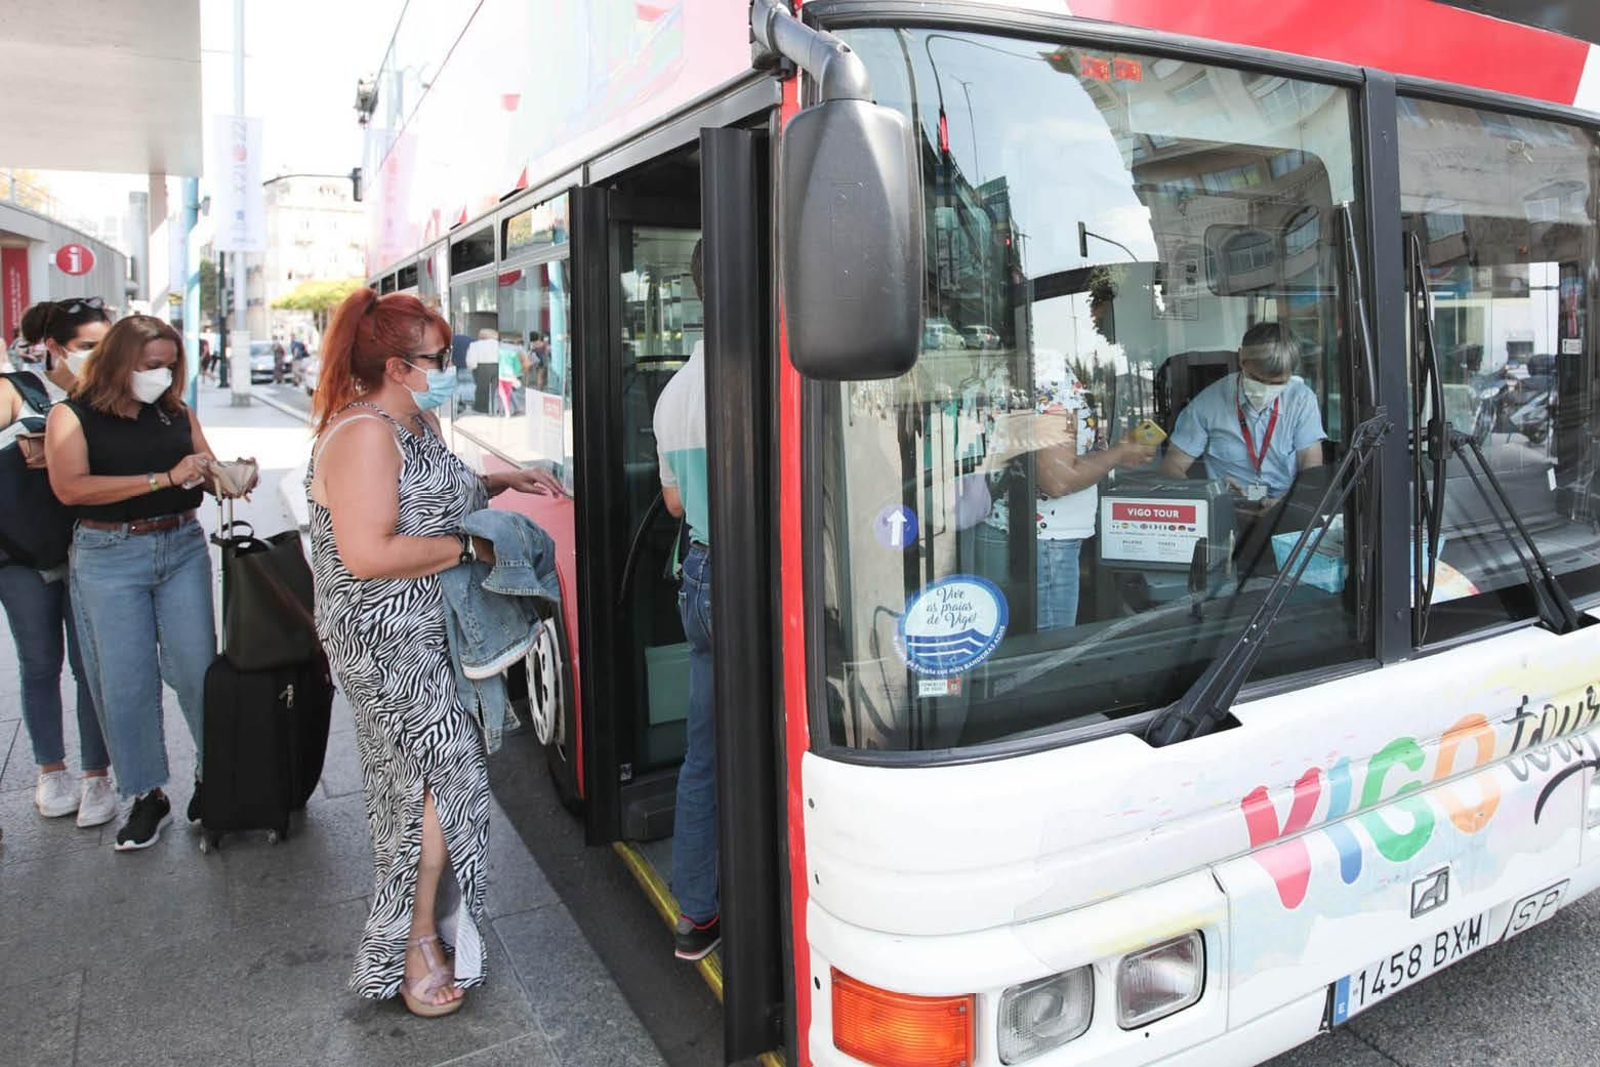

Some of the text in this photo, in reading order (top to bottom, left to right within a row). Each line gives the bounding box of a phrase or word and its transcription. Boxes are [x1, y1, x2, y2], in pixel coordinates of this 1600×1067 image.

[1127, 507, 1180, 518] VIGO TOUR
[936, 587, 966, 603] Vive
[926, 601, 973, 616] as praias
[926, 614, 940, 625] de
[1241, 713, 1501, 909] VIGO
[1513, 889, 1559, 931] SP
[1359, 912, 1483, 1005] 1458 BXM
